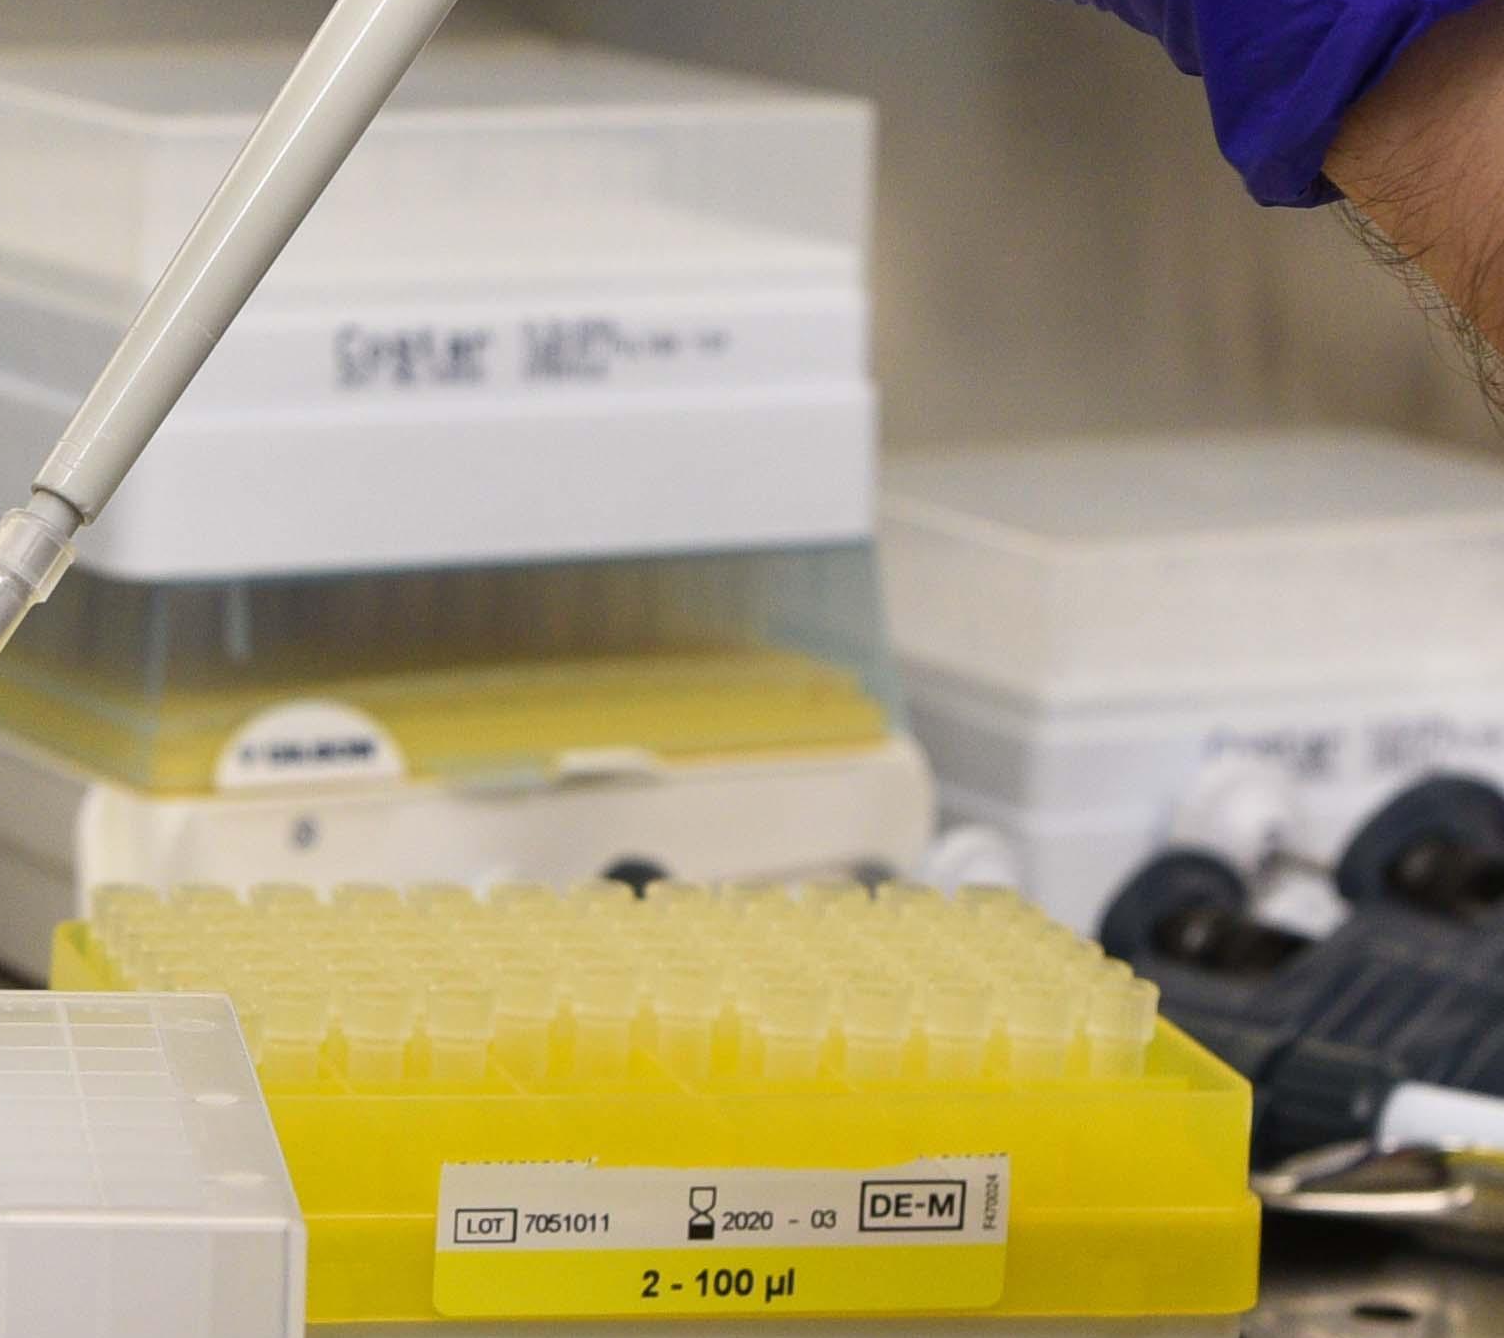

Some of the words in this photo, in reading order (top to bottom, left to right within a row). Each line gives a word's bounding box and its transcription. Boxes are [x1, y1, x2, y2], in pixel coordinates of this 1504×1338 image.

[869, 1193, 955, 1218] DE-M
[466, 1217, 505, 1235] LOT
[524, 1213, 610, 1233] 7051011
[722, 1211, 774, 1231] 2020
[810, 1210, 837, 1230] 03
[641, 1270, 660, 1298] 2
[695, 1267, 754, 1297] 100
